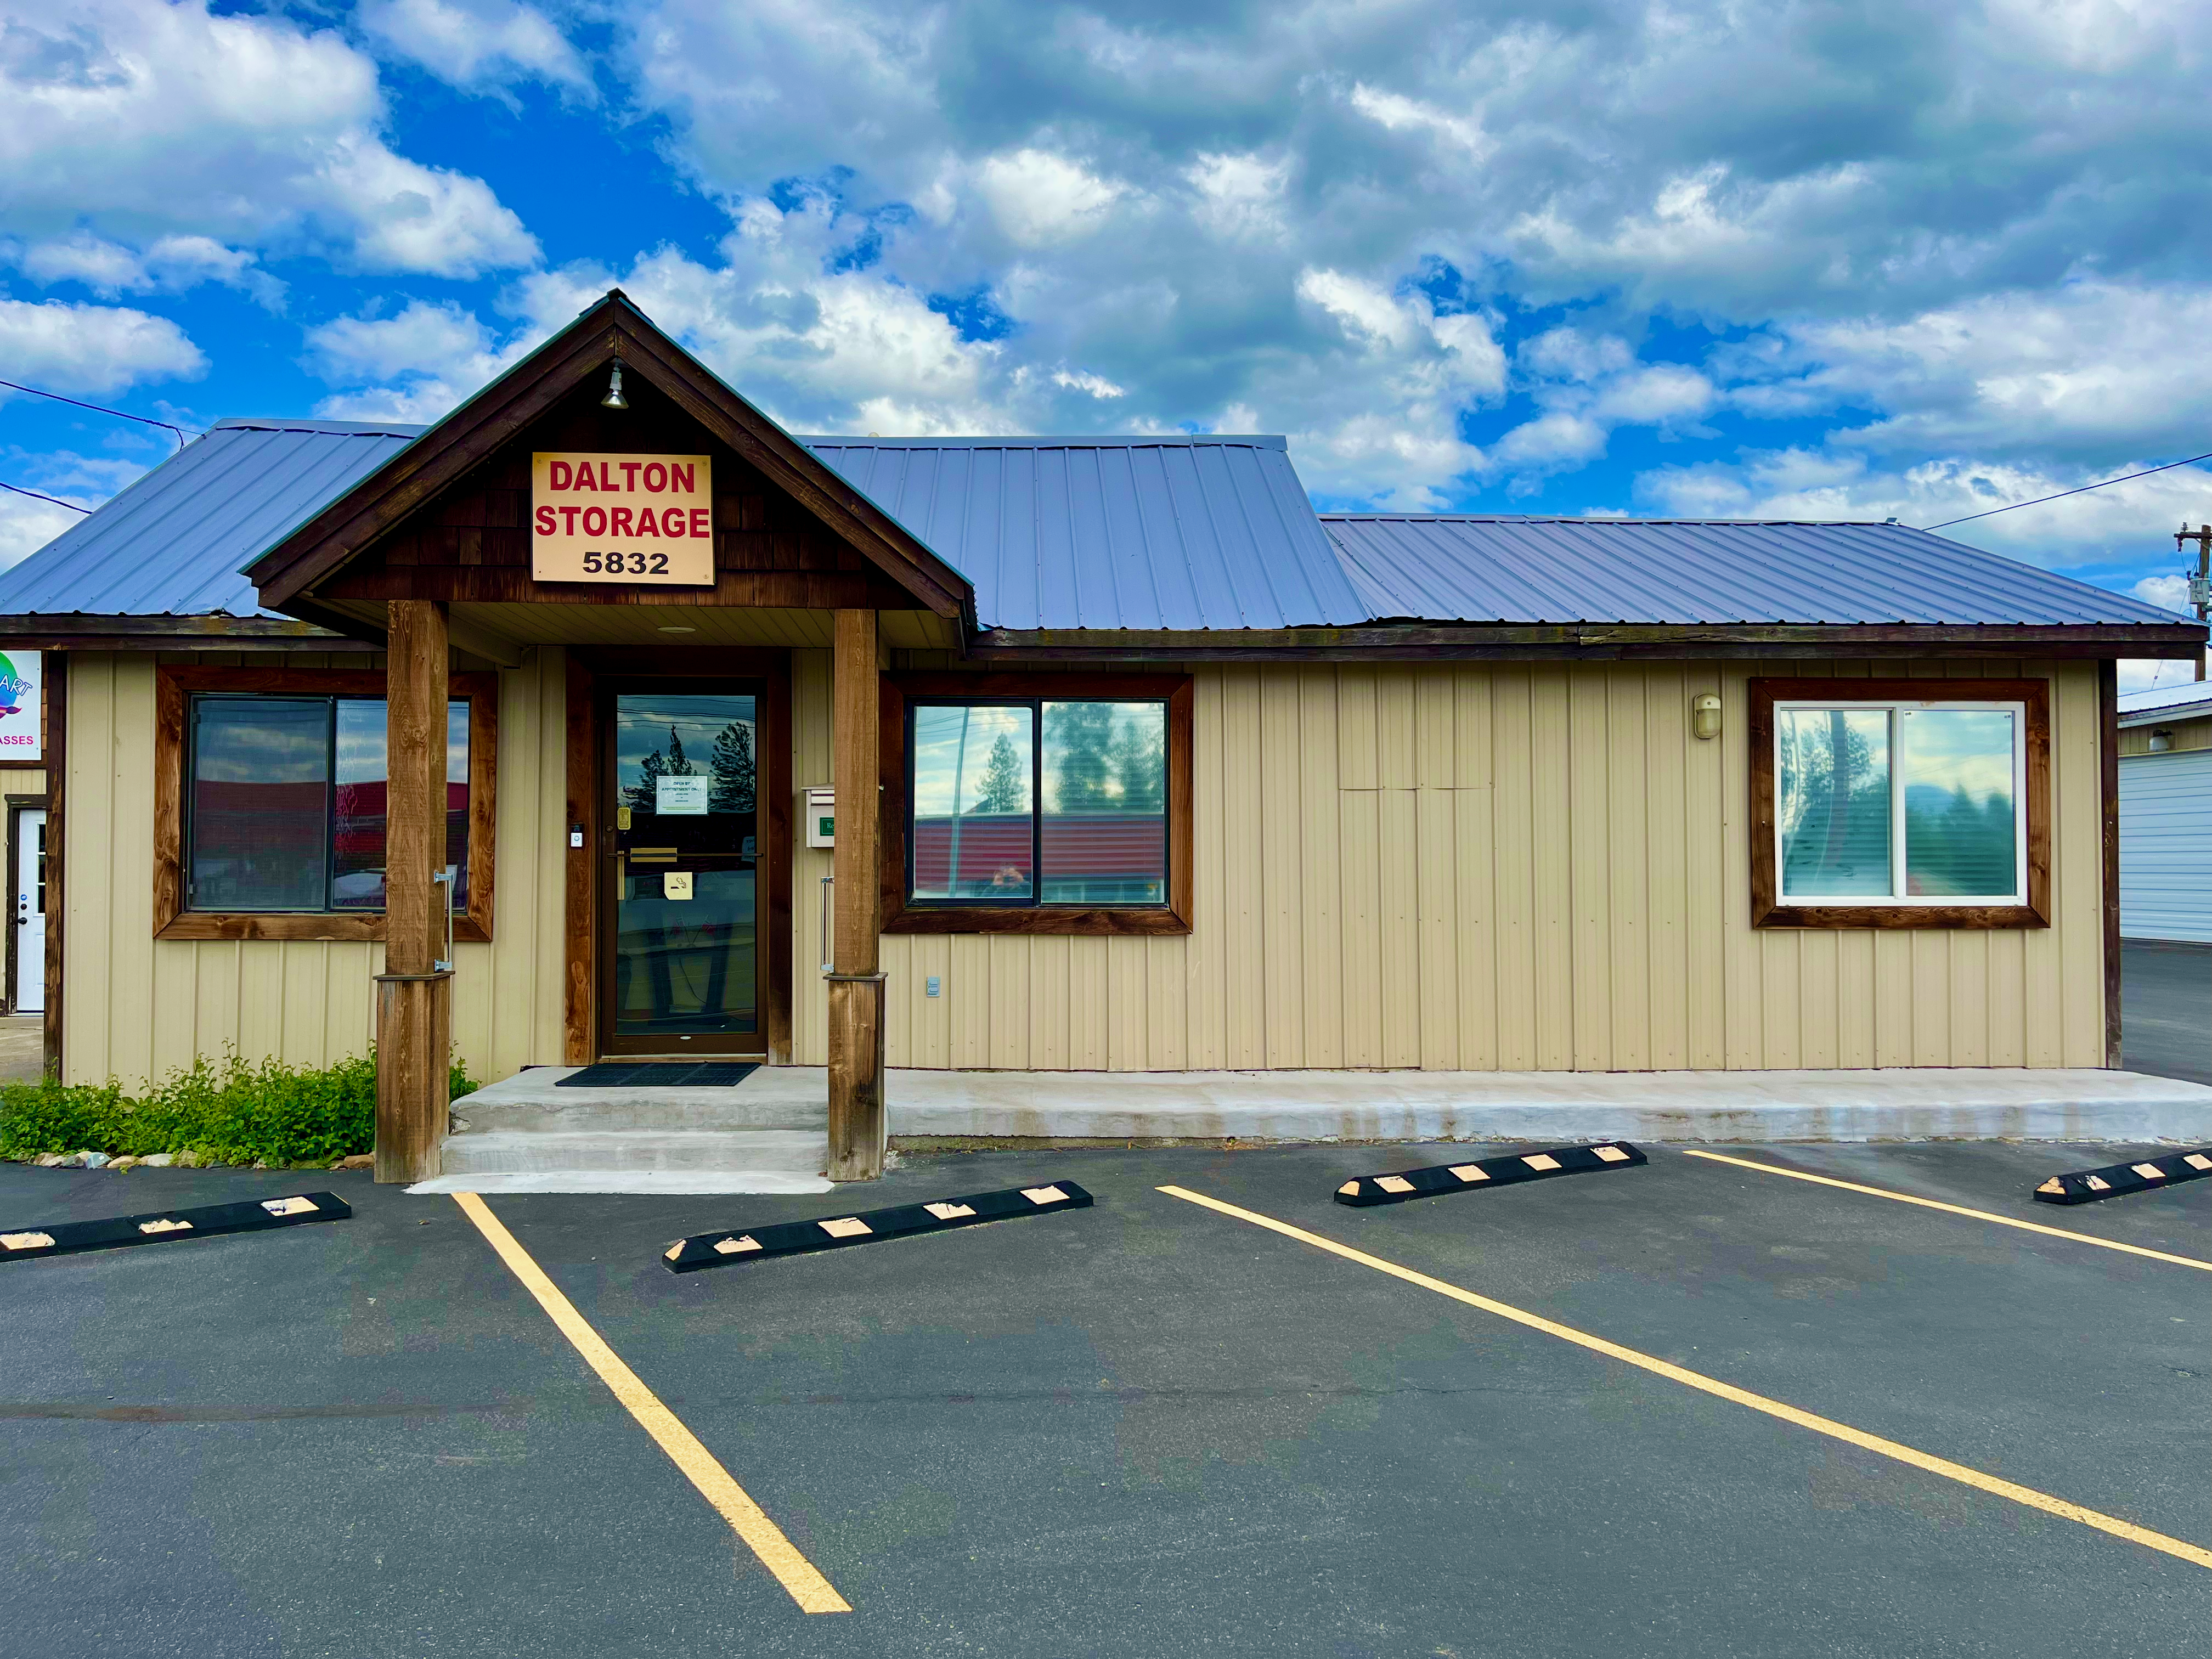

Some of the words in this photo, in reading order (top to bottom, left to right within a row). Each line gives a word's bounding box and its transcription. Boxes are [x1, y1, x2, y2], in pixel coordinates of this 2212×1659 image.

[550, 461, 695, 493] DALTON
[535, 505, 710, 538] STORAGE
[583, 551, 669, 575] 5832
[0, 674, 33, 696] ART
